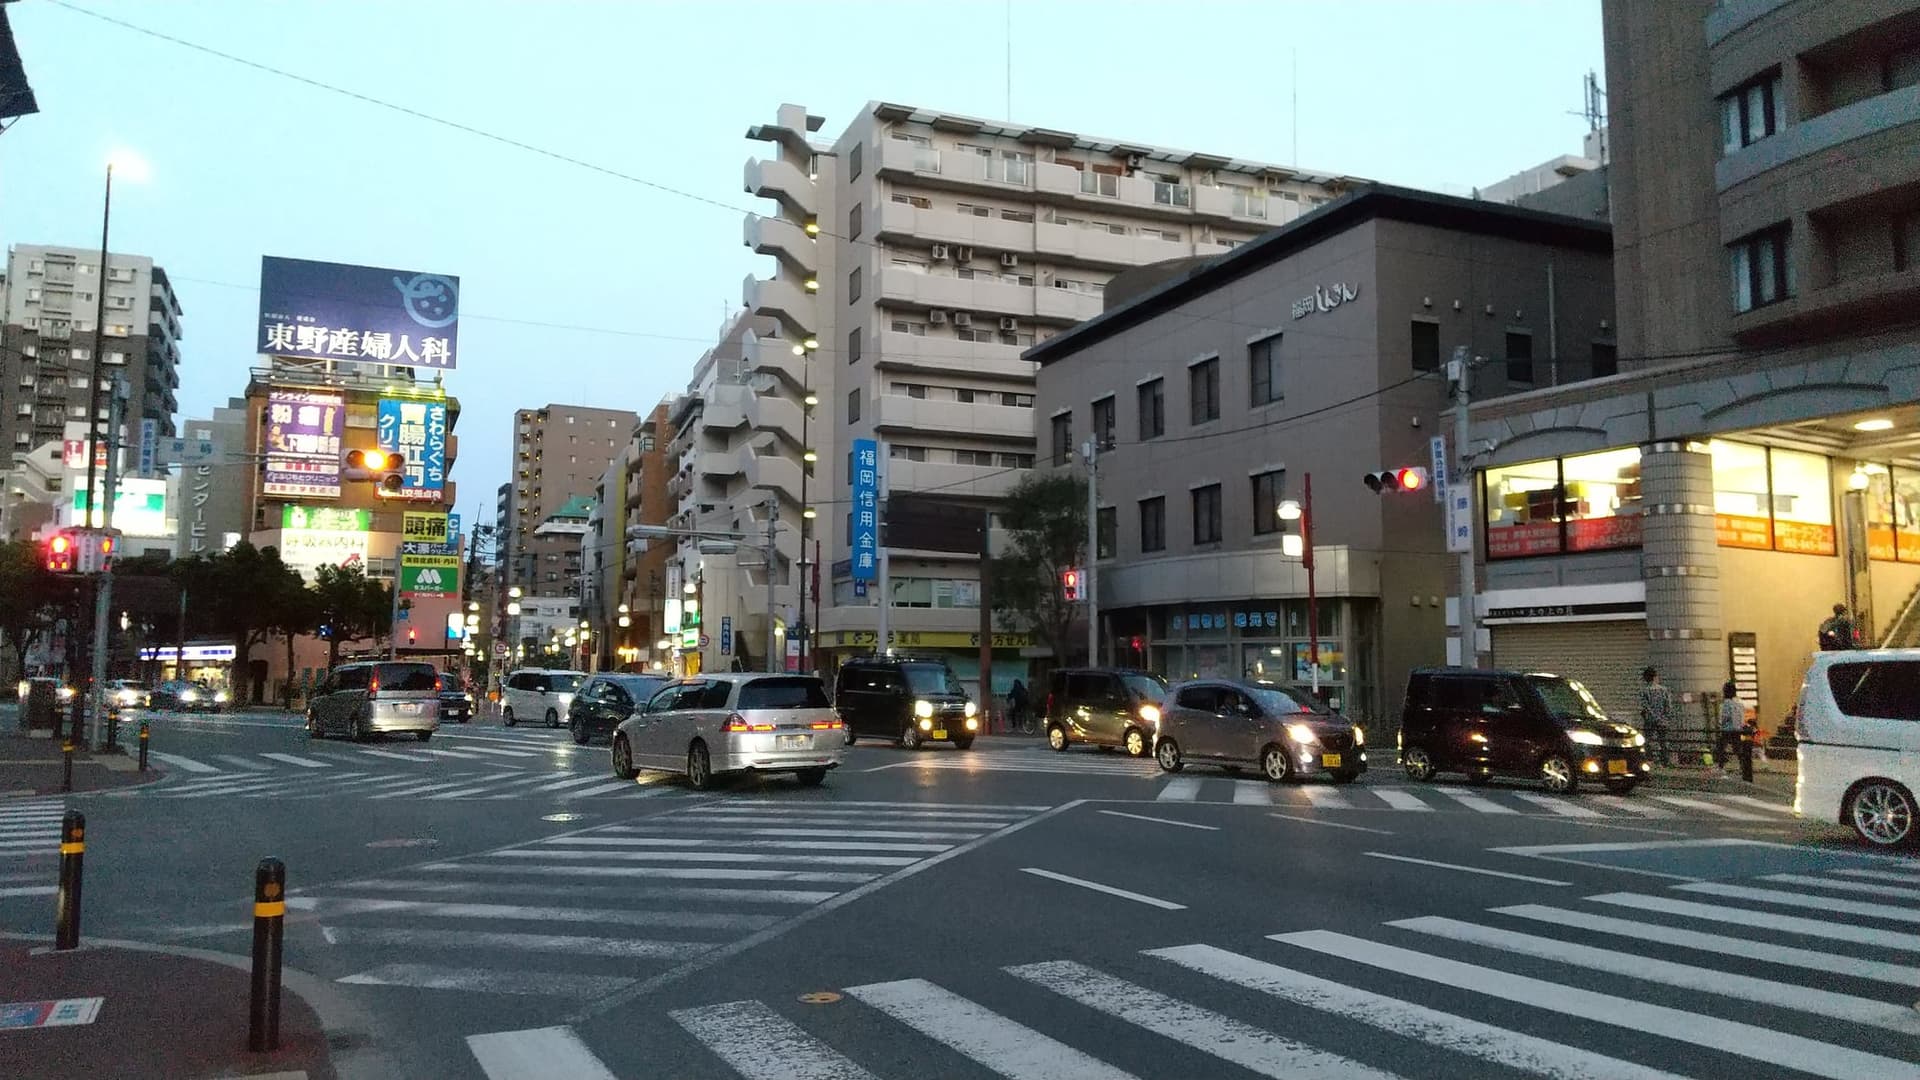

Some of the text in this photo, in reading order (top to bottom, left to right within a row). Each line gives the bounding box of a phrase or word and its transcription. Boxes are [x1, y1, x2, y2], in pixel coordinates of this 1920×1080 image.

[264, 322, 452, 365] 東野産婦人科
[190, 465, 211, 552] センタービル
[404, 516, 446, 536] 頭痛
[858, 449, 875, 569] 福岡信用金庫
